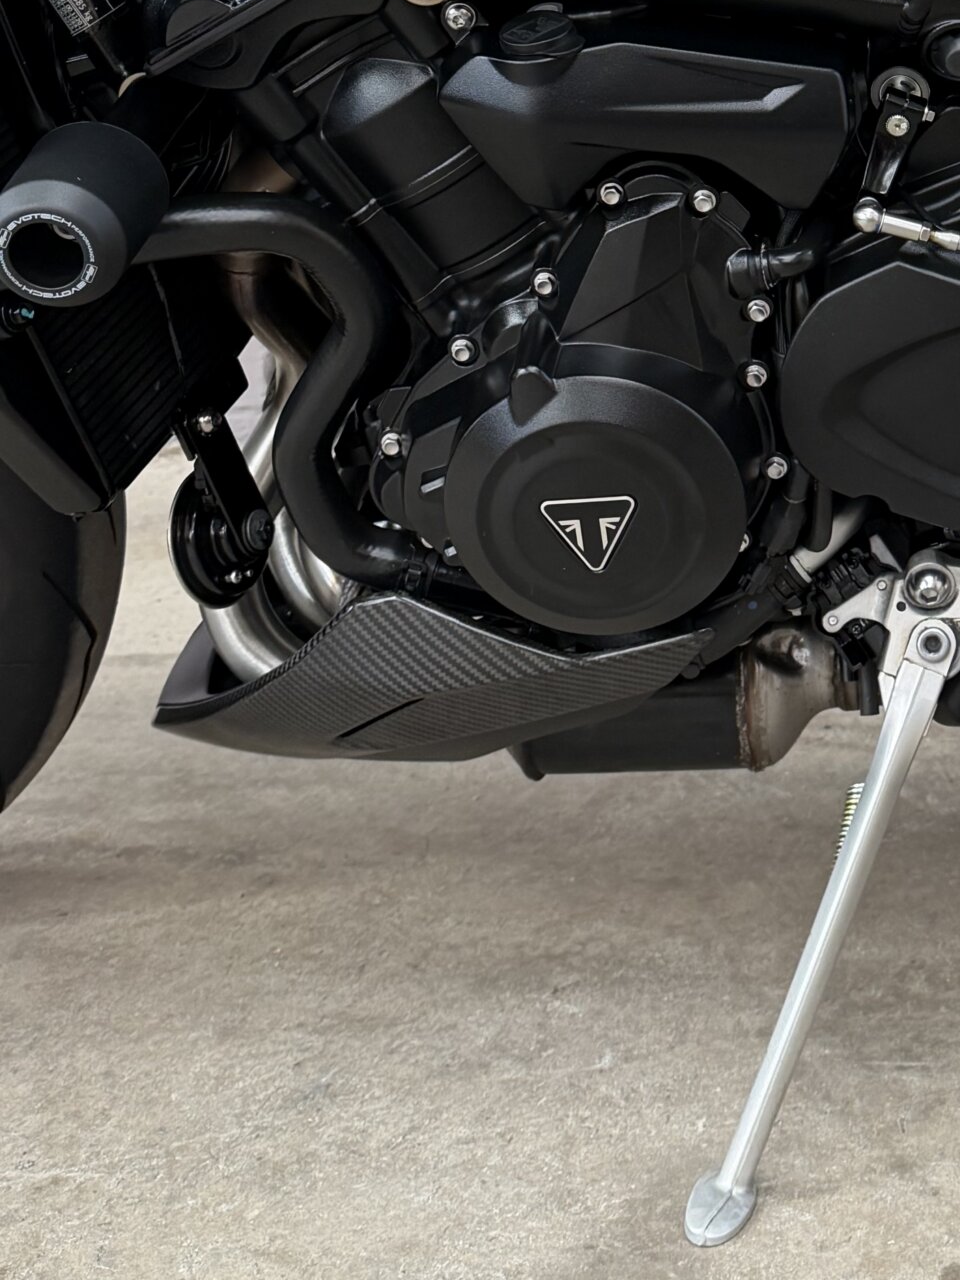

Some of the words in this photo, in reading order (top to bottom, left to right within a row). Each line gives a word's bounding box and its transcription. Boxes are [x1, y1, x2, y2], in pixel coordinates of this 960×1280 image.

[83, 10, 93, 21] kg
[7, 213, 72, 231] EVOTECH
[22, 281, 87, 298] EVOTECH
